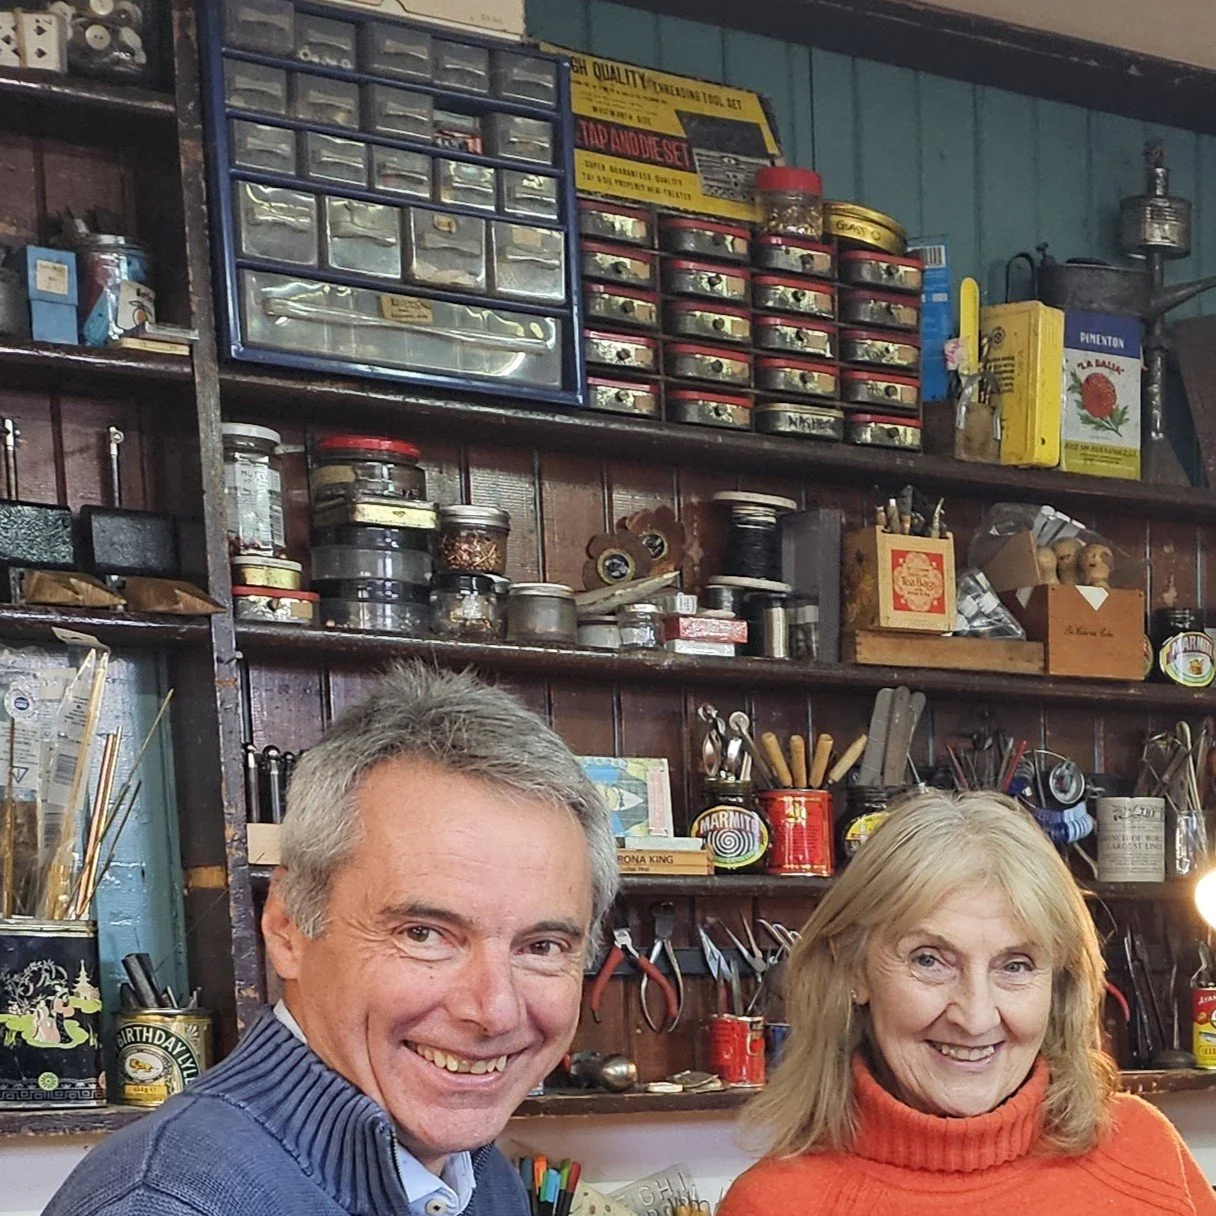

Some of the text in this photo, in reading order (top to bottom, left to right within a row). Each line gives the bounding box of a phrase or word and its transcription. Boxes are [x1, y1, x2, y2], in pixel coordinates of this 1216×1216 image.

[571, 56, 588, 76] GH
[593, 61, 647, 90] QUALITY
[652, 81, 700, 101] THREADING
[702, 92, 723, 107] TOOL
[726, 98, 743, 111] SET
[579, 119, 608, 150] TAP
[610, 127, 640, 158] AND
[655, 174, 683, 186] QUALITY
[1080, 331, 1125, 349] PIMENTON
[617, 855, 674, 864] RONA KING
[117, 1026, 186, 1056] BIRTHDAY
